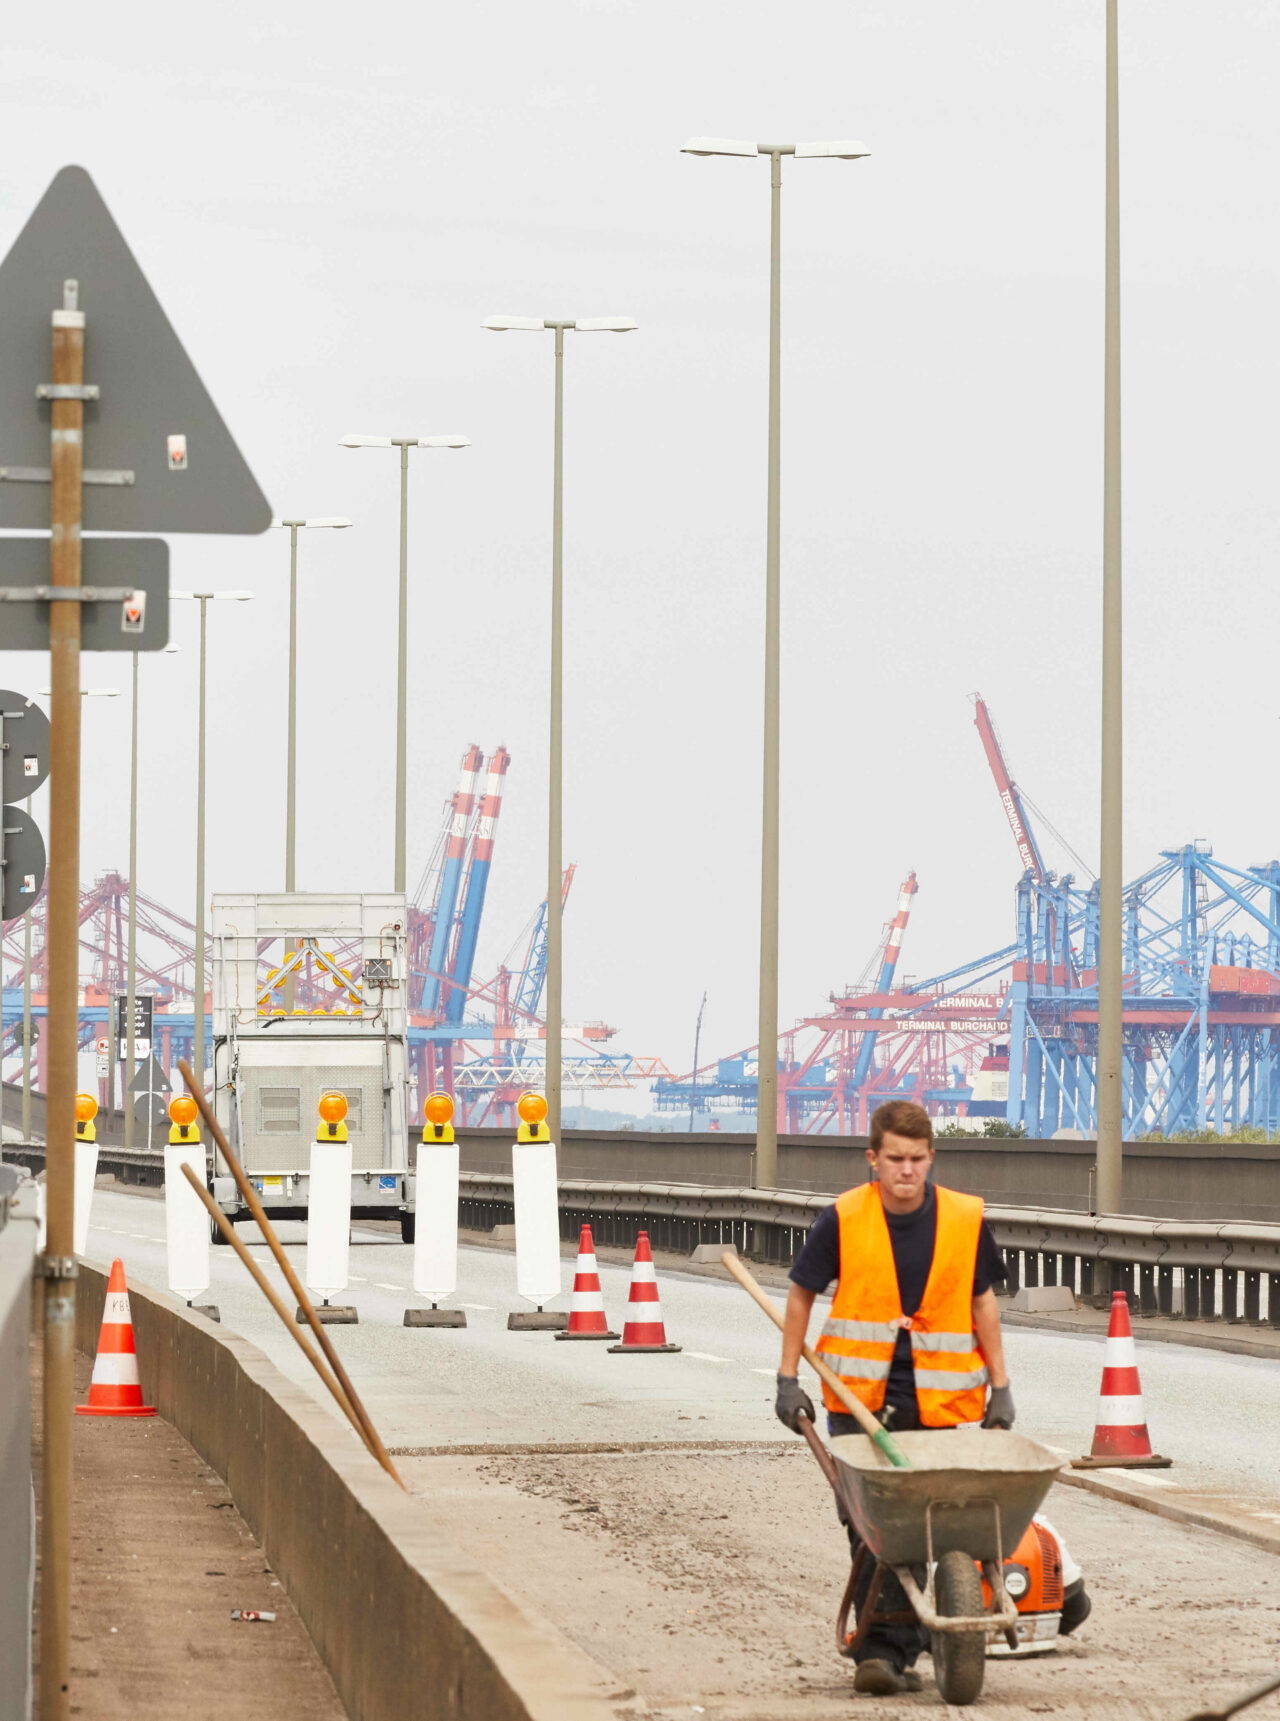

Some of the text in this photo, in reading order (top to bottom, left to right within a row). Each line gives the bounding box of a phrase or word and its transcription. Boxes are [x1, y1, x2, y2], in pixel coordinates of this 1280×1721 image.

[1000, 788, 1025, 842] TERMINAL
[932, 996, 993, 1008] TERMINAL
[896, 1020, 1012, 1032] TERMINAL BURCHARD
